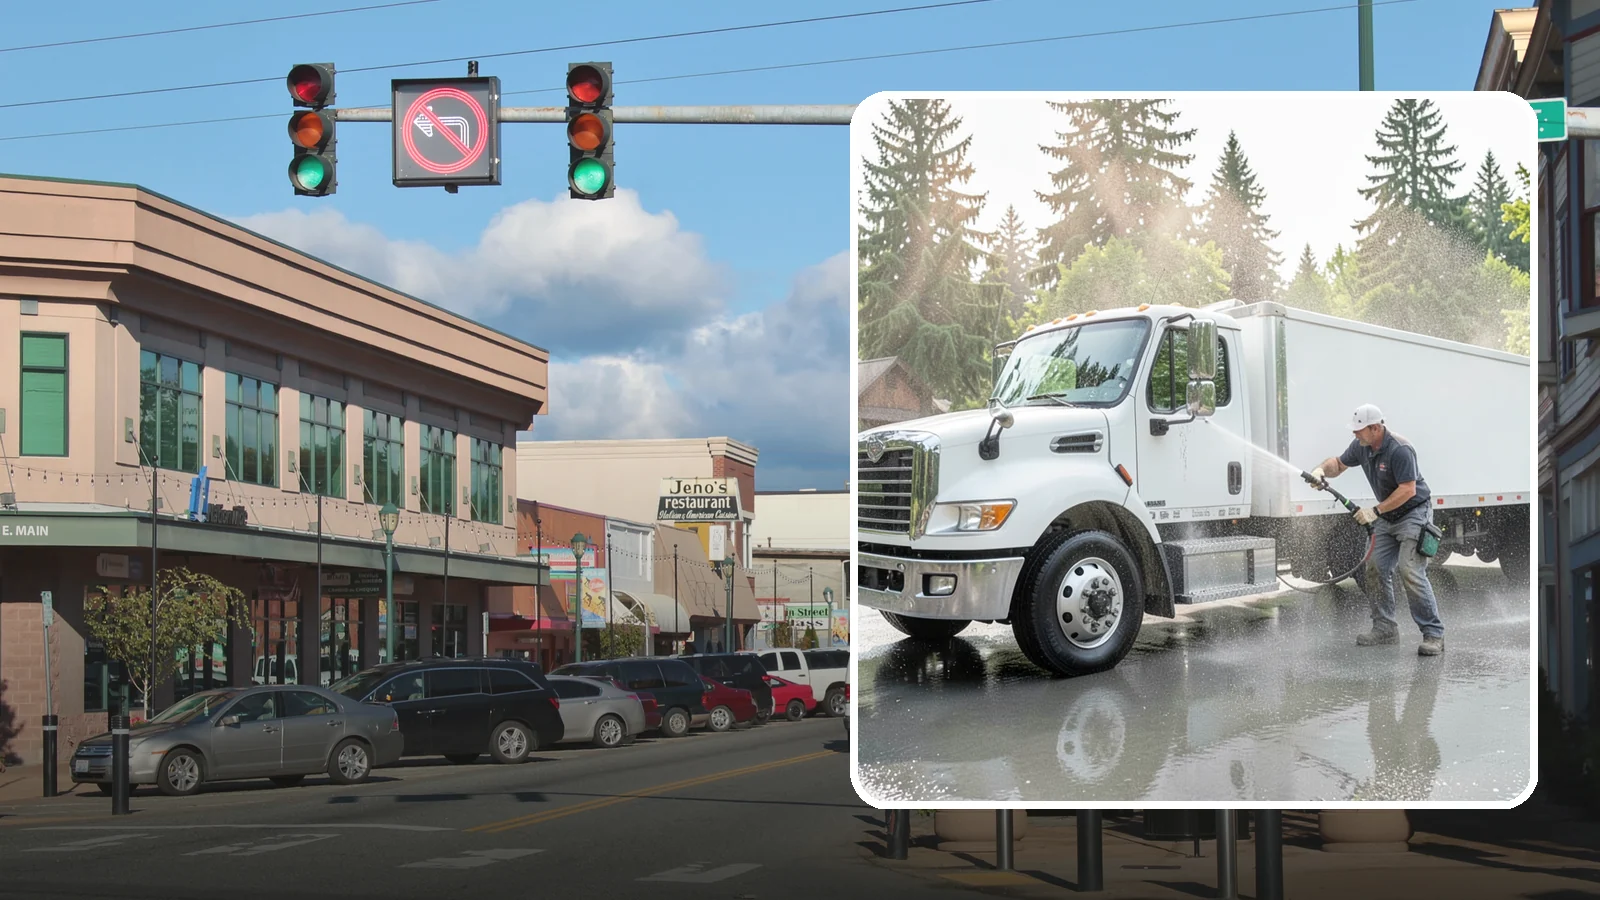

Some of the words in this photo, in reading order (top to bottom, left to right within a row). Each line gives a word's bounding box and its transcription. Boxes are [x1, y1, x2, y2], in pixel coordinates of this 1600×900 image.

[669, 480, 728, 494] Jeno's
[665, 496, 731, 509] restaurant
[659, 510, 681, 519] Italian
[686, 510, 714, 519] American
[715, 509, 738, 519] Cuisine
[2, 525, 13, 536] E.
[15, 525, 49, 536] MAIN
[797, 607, 828, 617] Street
[789, 619, 824, 627] lass
